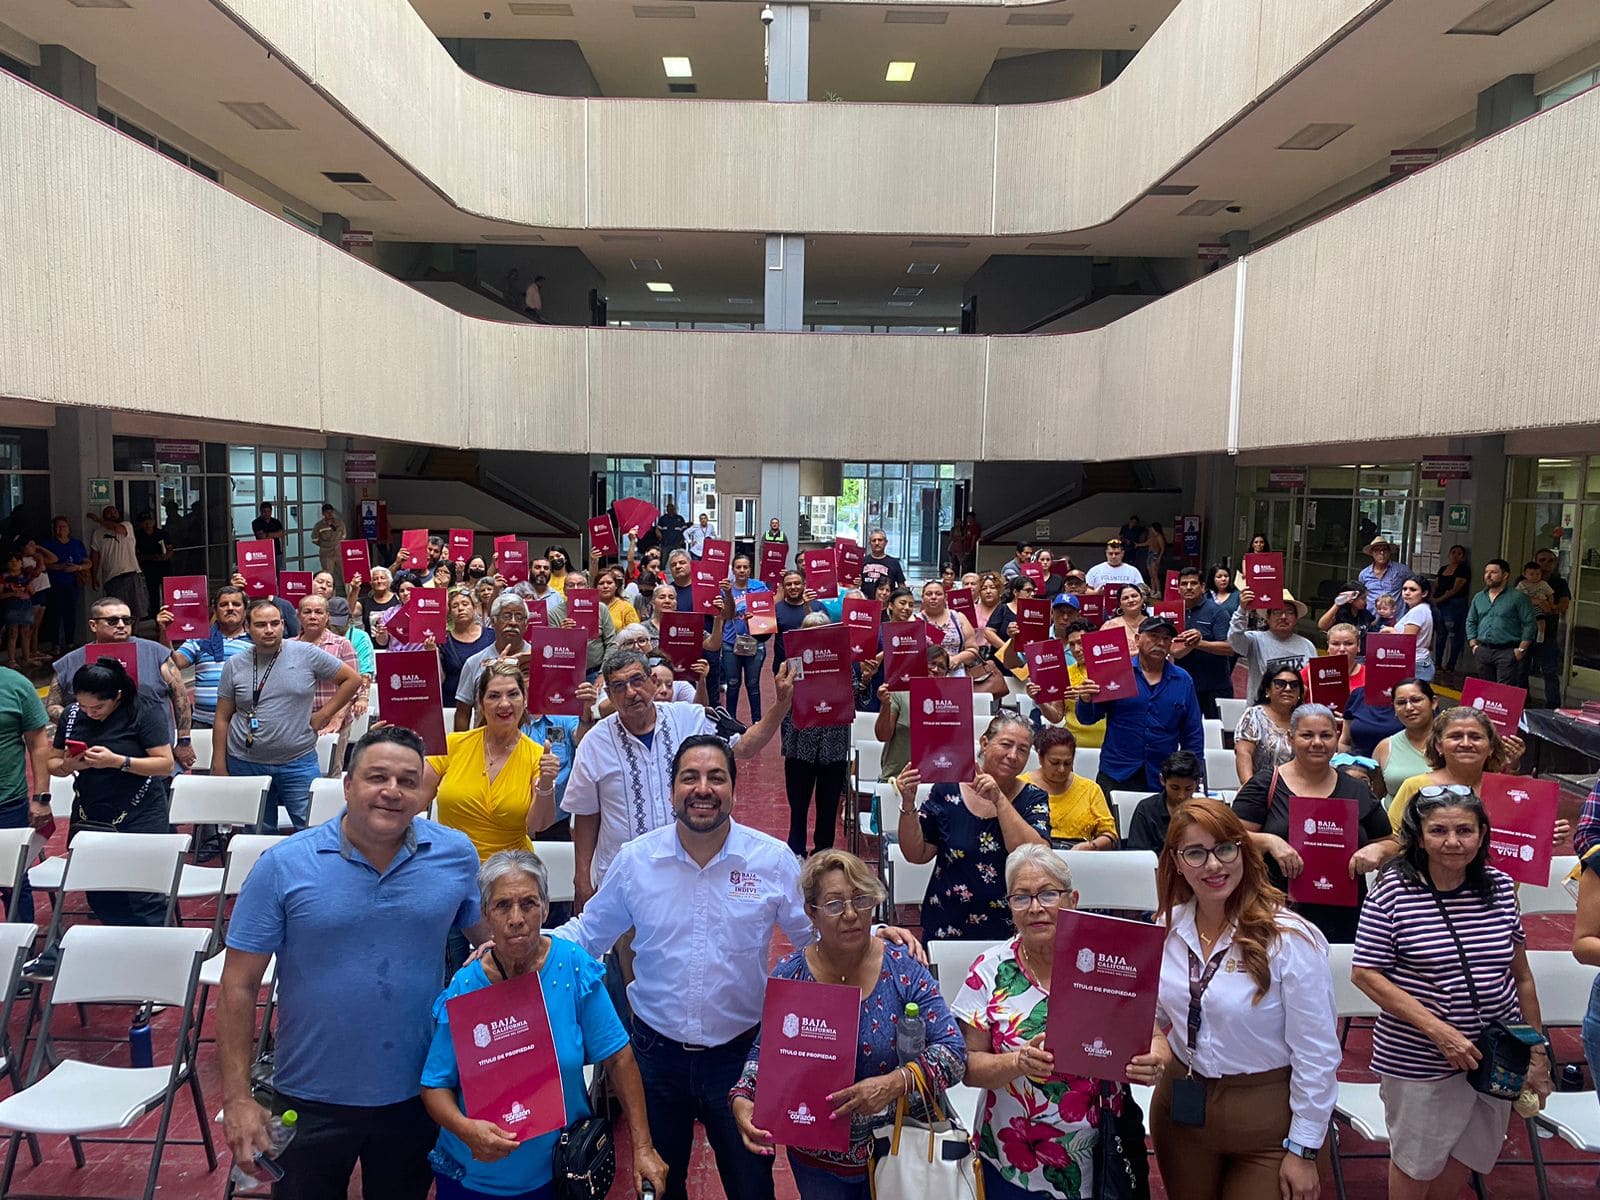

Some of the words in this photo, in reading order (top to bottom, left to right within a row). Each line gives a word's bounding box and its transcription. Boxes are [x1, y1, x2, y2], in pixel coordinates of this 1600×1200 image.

[1098, 953, 1127, 966] BAJA
[1097, 961, 1137, 972] CALIFORNIA
[490, 1015, 517, 1030] BAJA
[492, 1020, 528, 1035] CALIFORNIA
[801, 1017, 828, 1028] BAJA
[801, 1025, 837, 1034] CALIFORNIA
